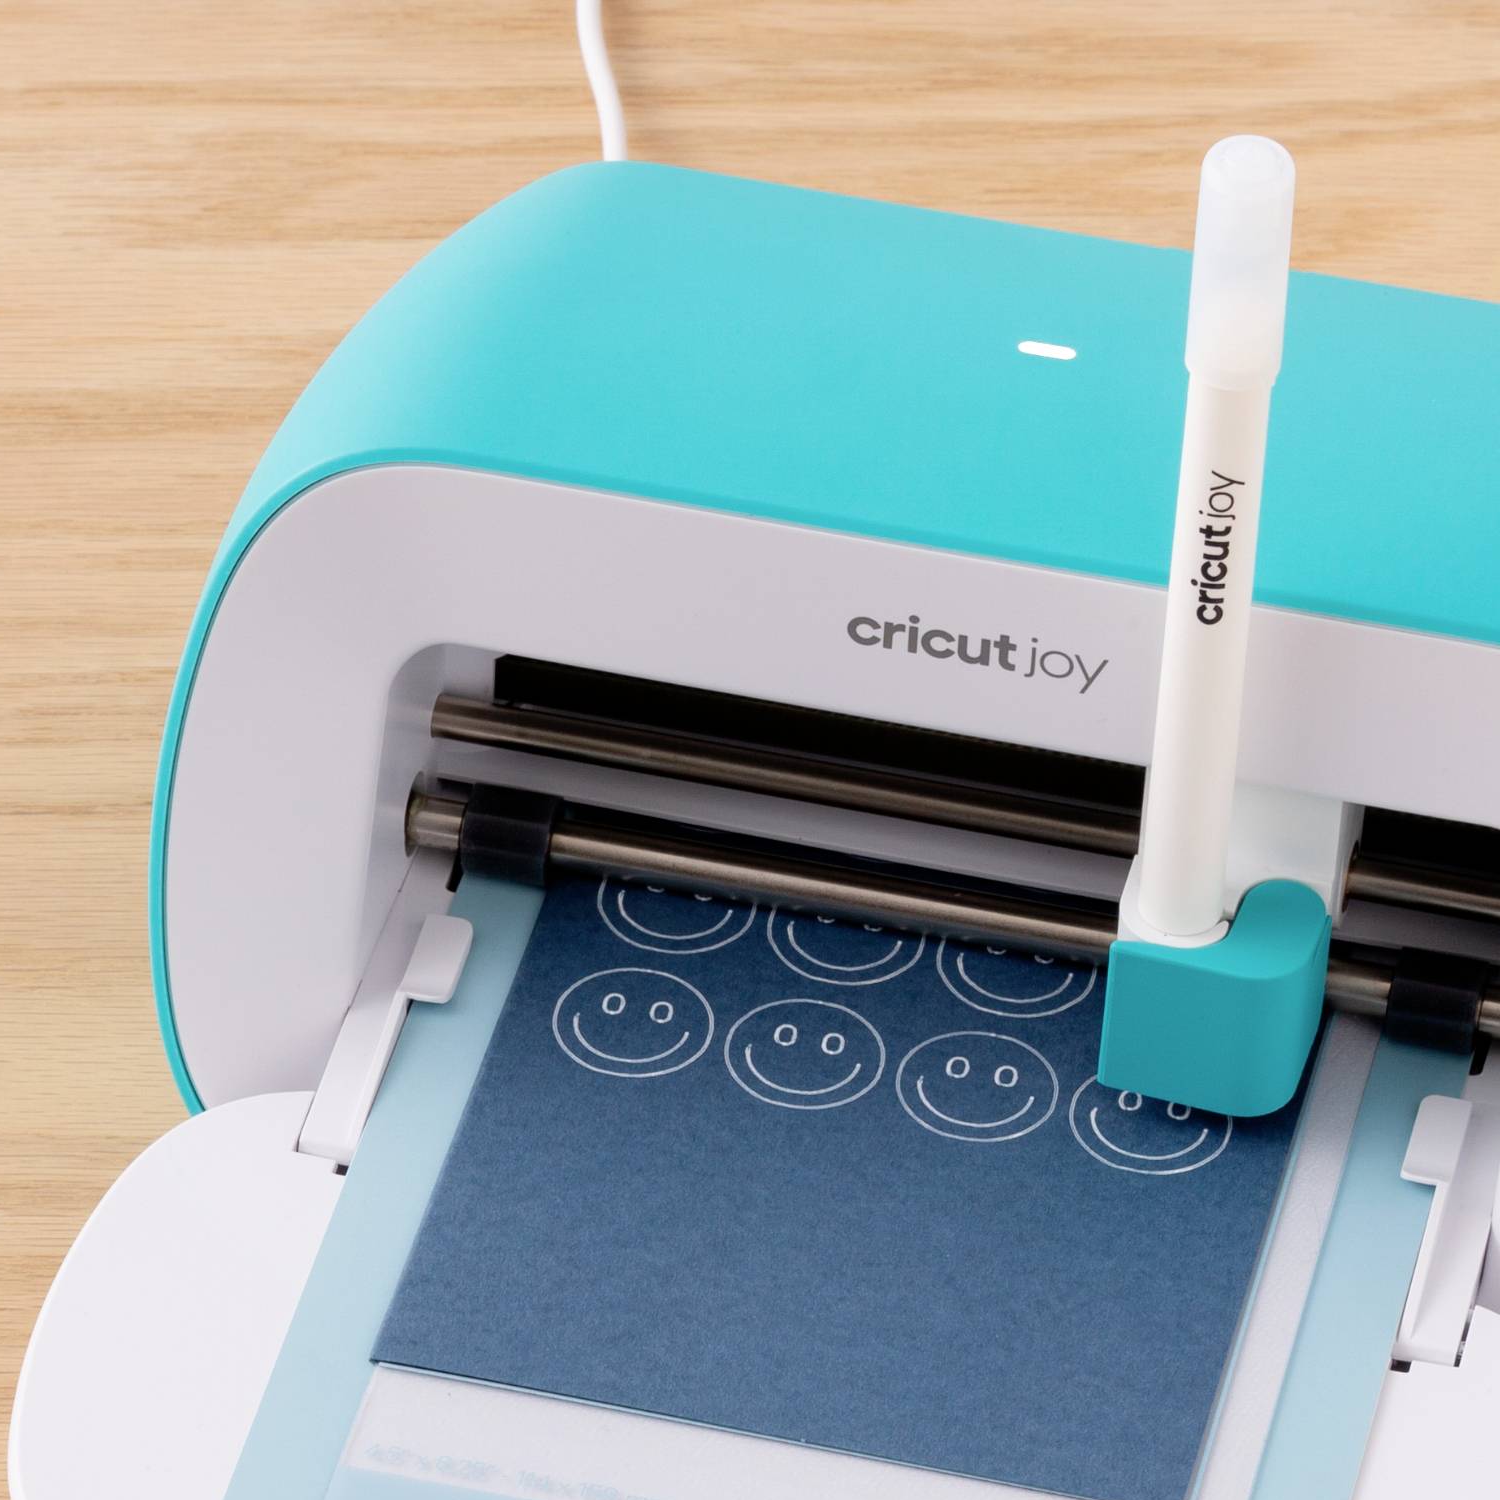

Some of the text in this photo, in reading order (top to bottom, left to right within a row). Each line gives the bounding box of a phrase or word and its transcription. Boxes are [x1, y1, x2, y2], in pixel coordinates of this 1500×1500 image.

[1190, 470, 1246, 626] cricut joy
[846, 614, 1110, 694] cricut joy
